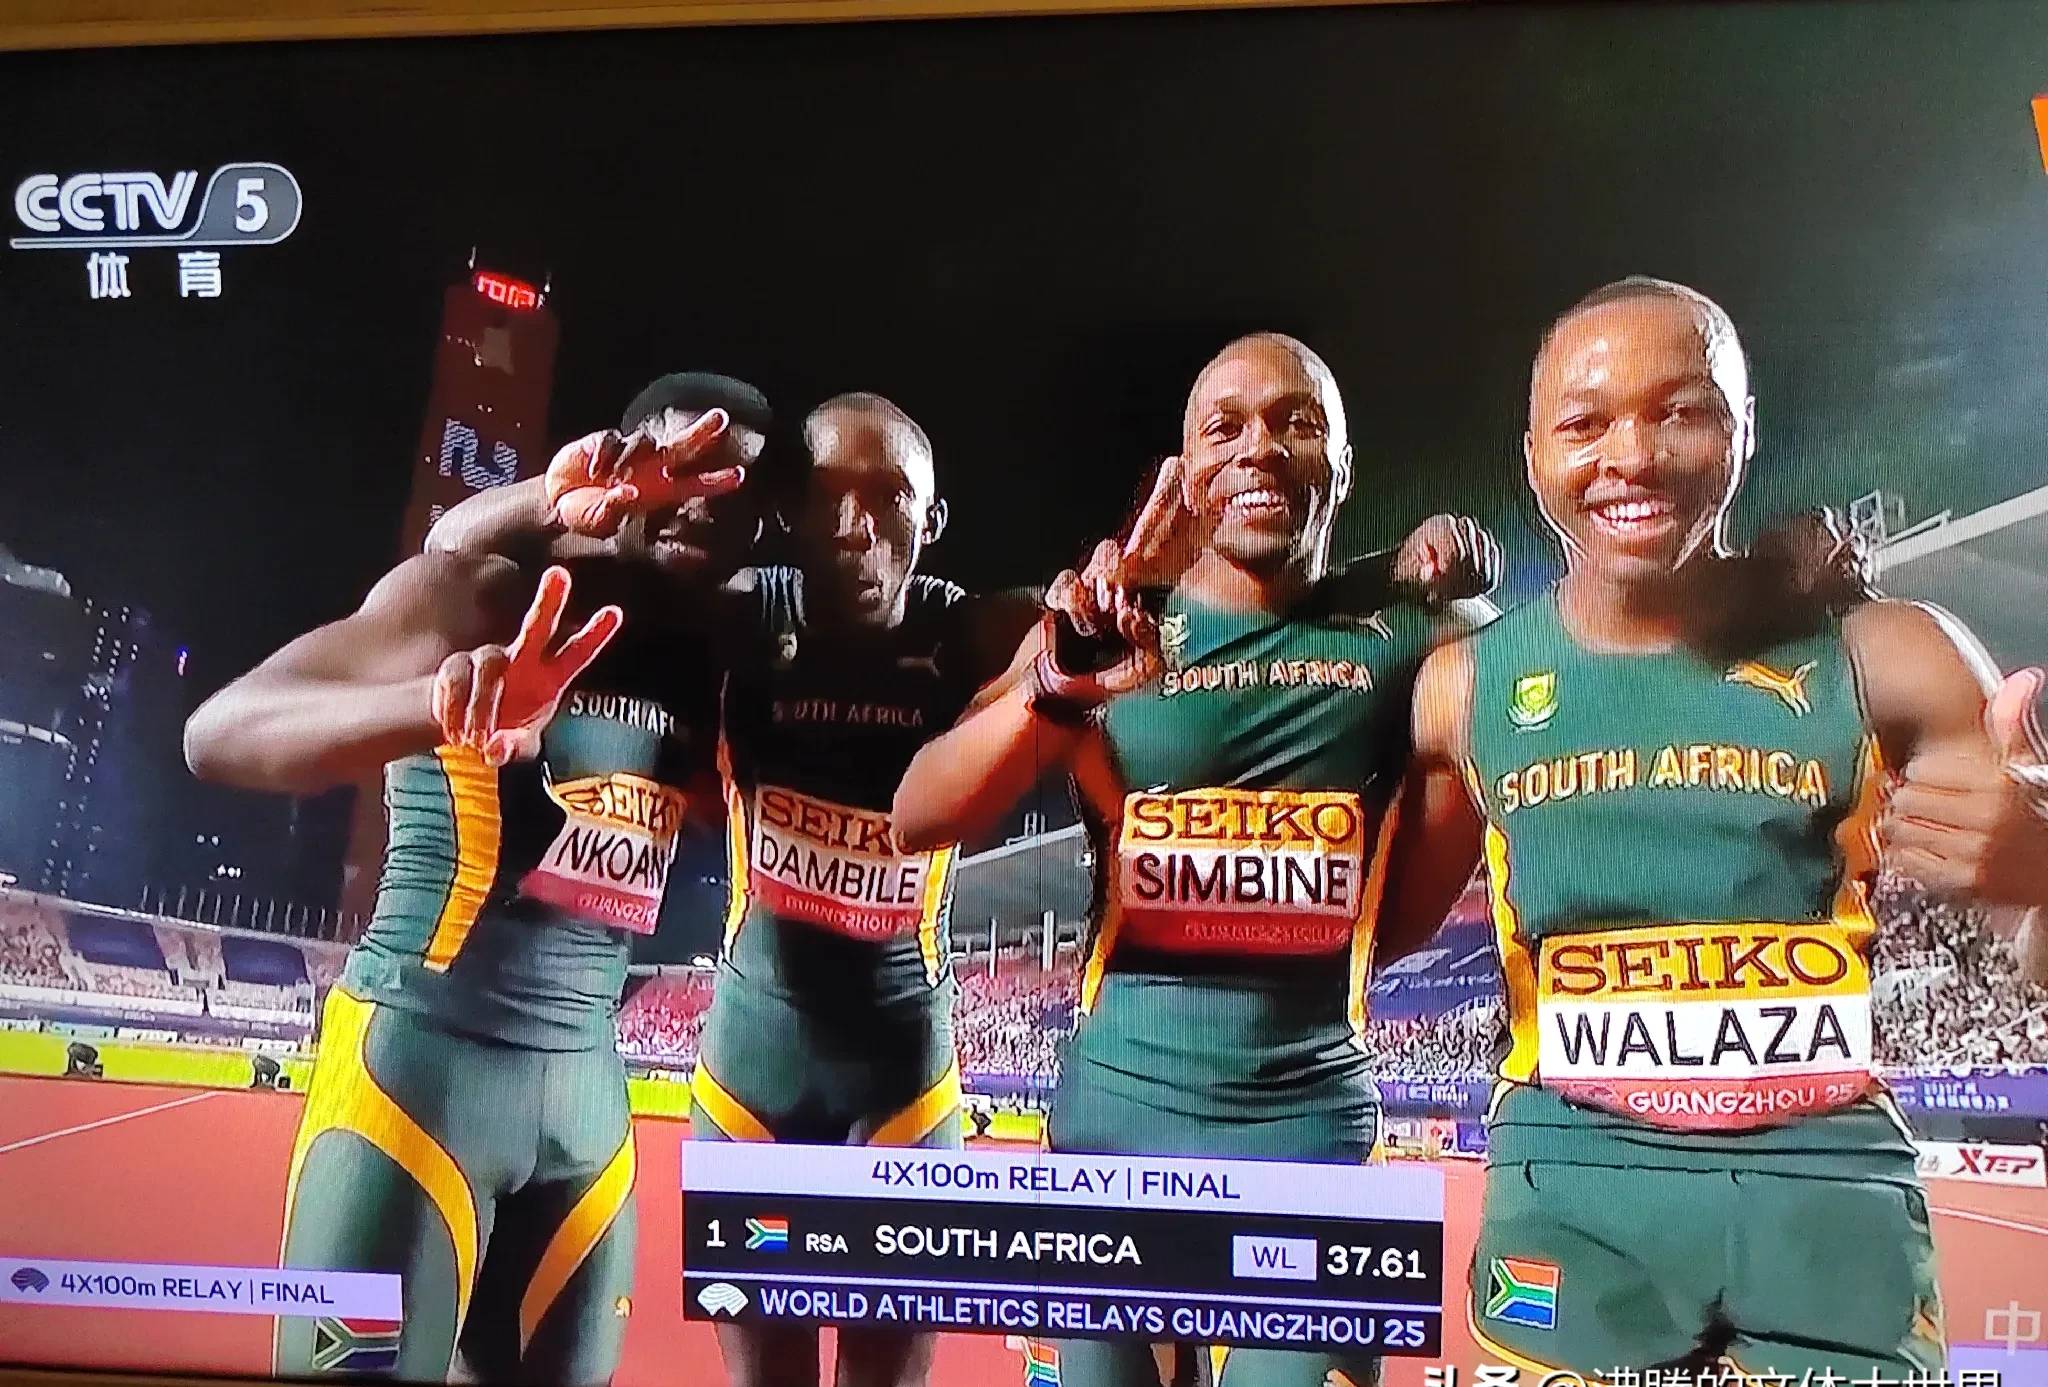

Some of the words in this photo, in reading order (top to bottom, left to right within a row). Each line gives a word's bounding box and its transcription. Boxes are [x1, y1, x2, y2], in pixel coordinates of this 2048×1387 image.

[15, 170, 198, 232] CCTV
[235, 177, 269, 232] 5
[87, 252, 222, 299] 体育
[1161, 659, 1259, 698] SOUTH
[1268, 658, 1373, 694] AFRICA
[570, 690, 641, 729] SOUTH
[1497, 748, 1637, 814] SOUTH
[1648, 743, 1829, 808] AFRICA
[1131, 797, 1358, 845] SEIKO
[759, 832, 919, 904] DAMBILE
[1132, 852, 1350, 909] SIMBINE
[1551, 935, 1848, 996] SEIKO
[1555, 1004, 1852, 1067] WALAZA
[1627, 1085, 1816, 1116] GUANGZHOU
[1825, 1083, 1857, 1103] 25
[872, 1160, 999, 1190] 4X100m
[1009, 1166, 1118, 1194] RELAY
[1142, 1171, 1241, 1200] FINAL
[705, 1218, 727, 1248] 1
[805, 1233, 849, 1254] RSA
[874, 1223, 998, 1258] SOUTH
[1006, 1230, 1142, 1266] AFRICA
[1252, 1245, 1297, 1270] WL
[1326, 1245, 1427, 1280] 37.61
[61, 1273, 157, 1297] 4X100m
[163, 1278, 243, 1301] RELAY
[261, 1282, 335, 1305] FINAL
[760, 1287, 868, 1319] WORLD
[876, 1293, 1040, 1329] ATHLETICS
[1047, 1301, 1164, 1334] RELAYS
[1171, 1307, 1376, 1343] GUANGZHOU
[1383, 1318, 1426, 1348] 25
[1984, 1300, 2042, 1357] 中
